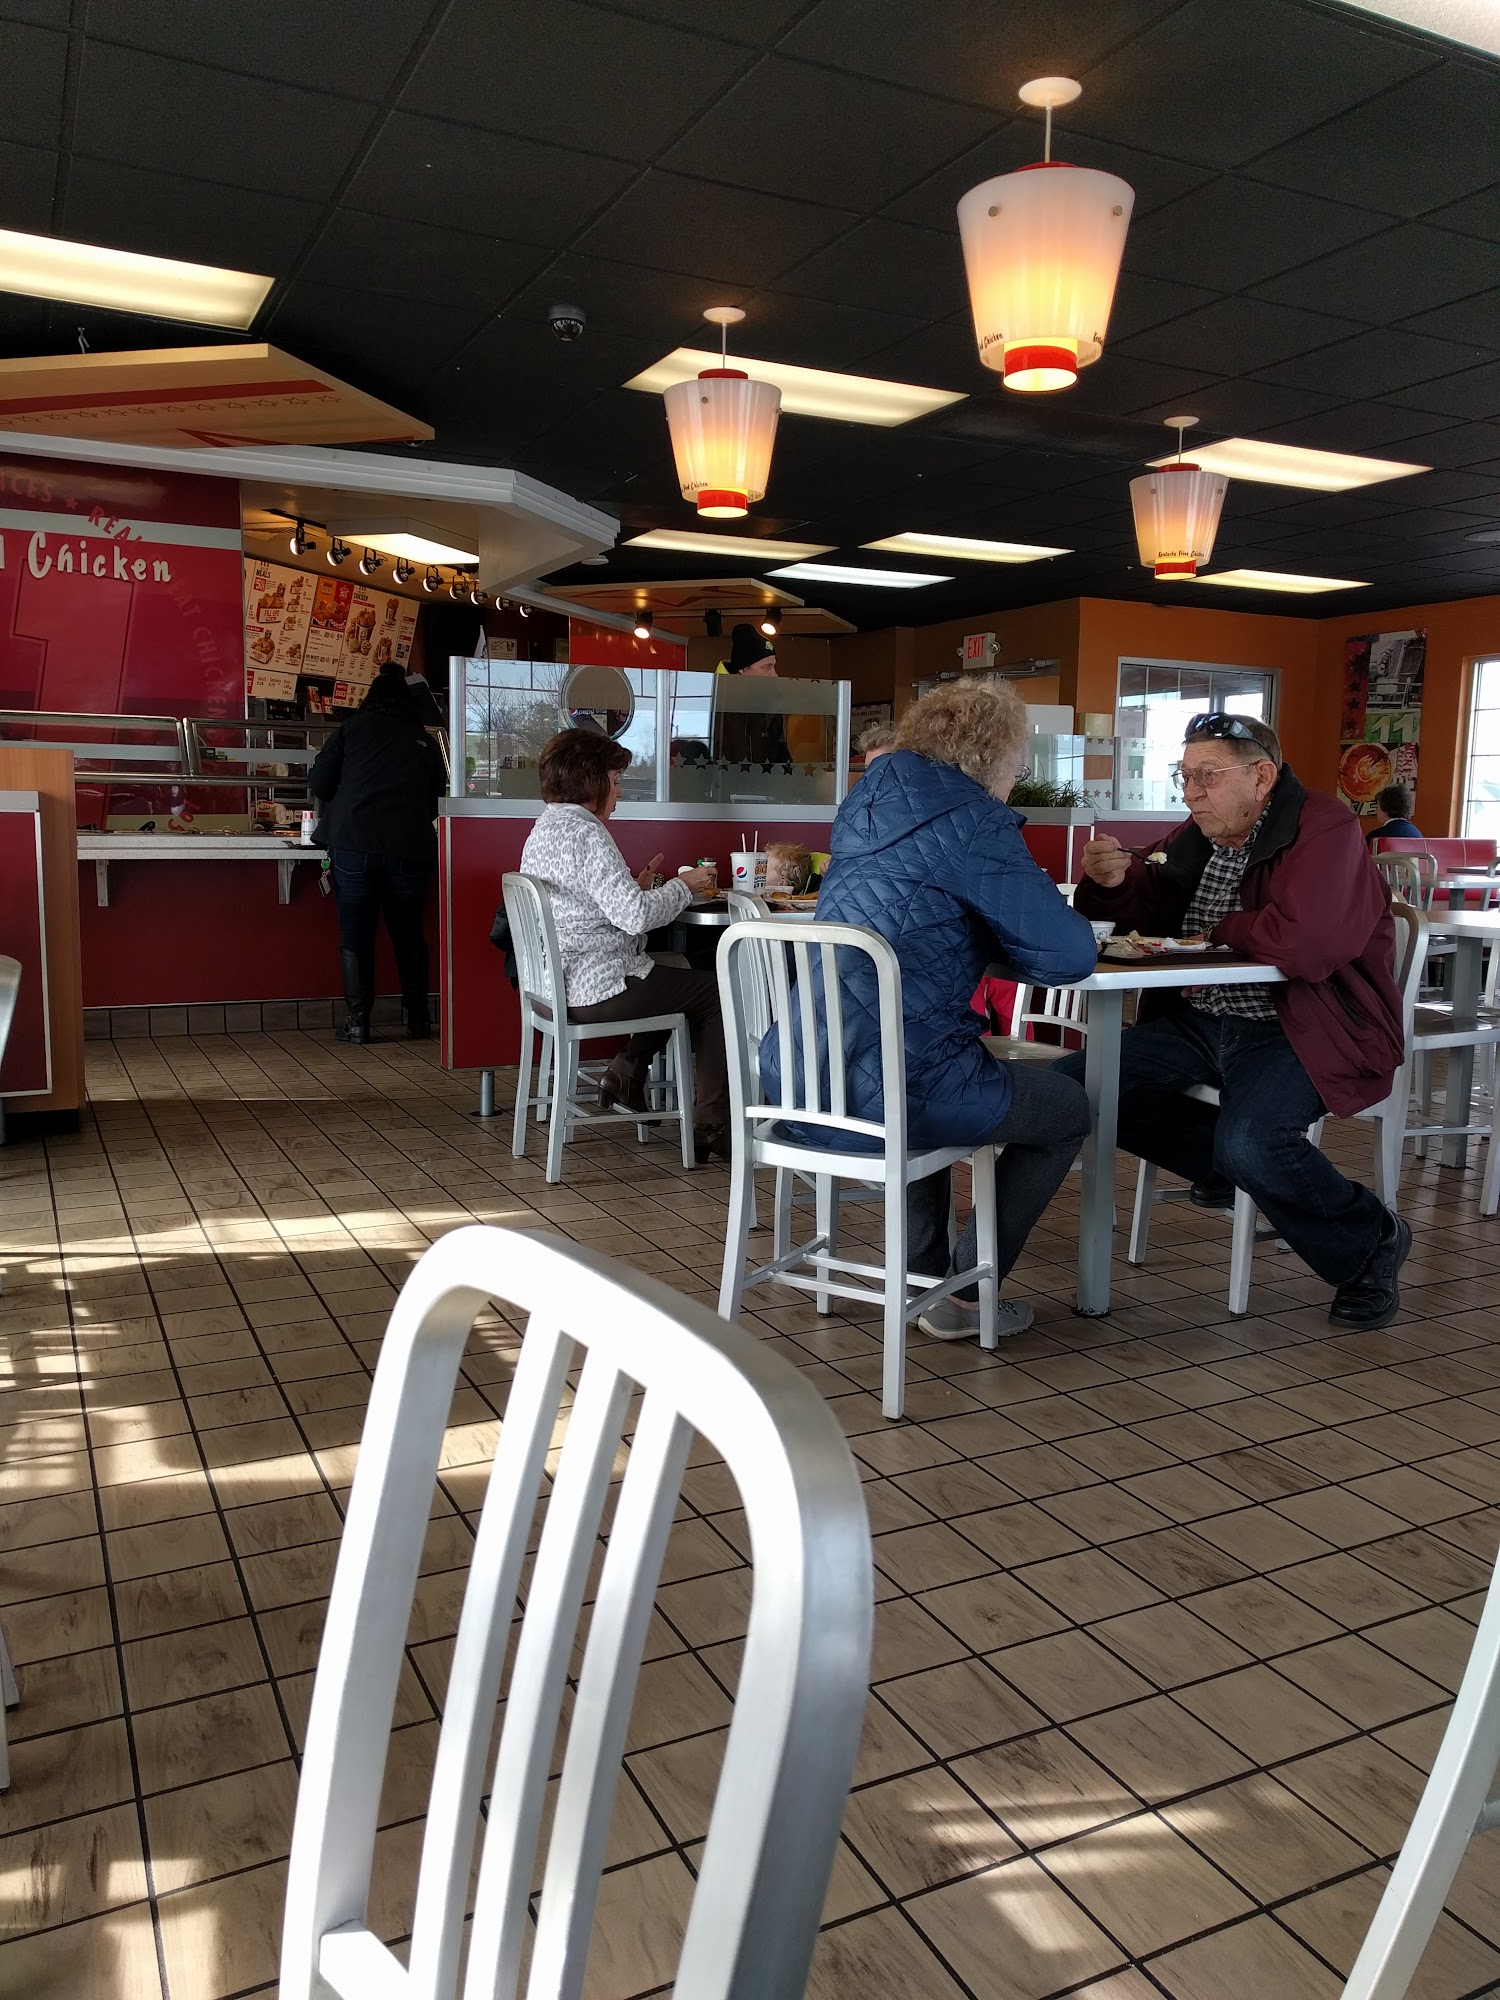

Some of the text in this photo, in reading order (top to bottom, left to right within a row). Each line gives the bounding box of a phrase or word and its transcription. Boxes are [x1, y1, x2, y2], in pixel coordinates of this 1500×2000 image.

[984, 332, 1003, 348] Chicken
[690, 482, 708, 490] Chicken
[27, 531, 172, 582] Chicken
[967, 635, 986, 659] EXIT
[191, 626, 227, 719] CHICKEN
